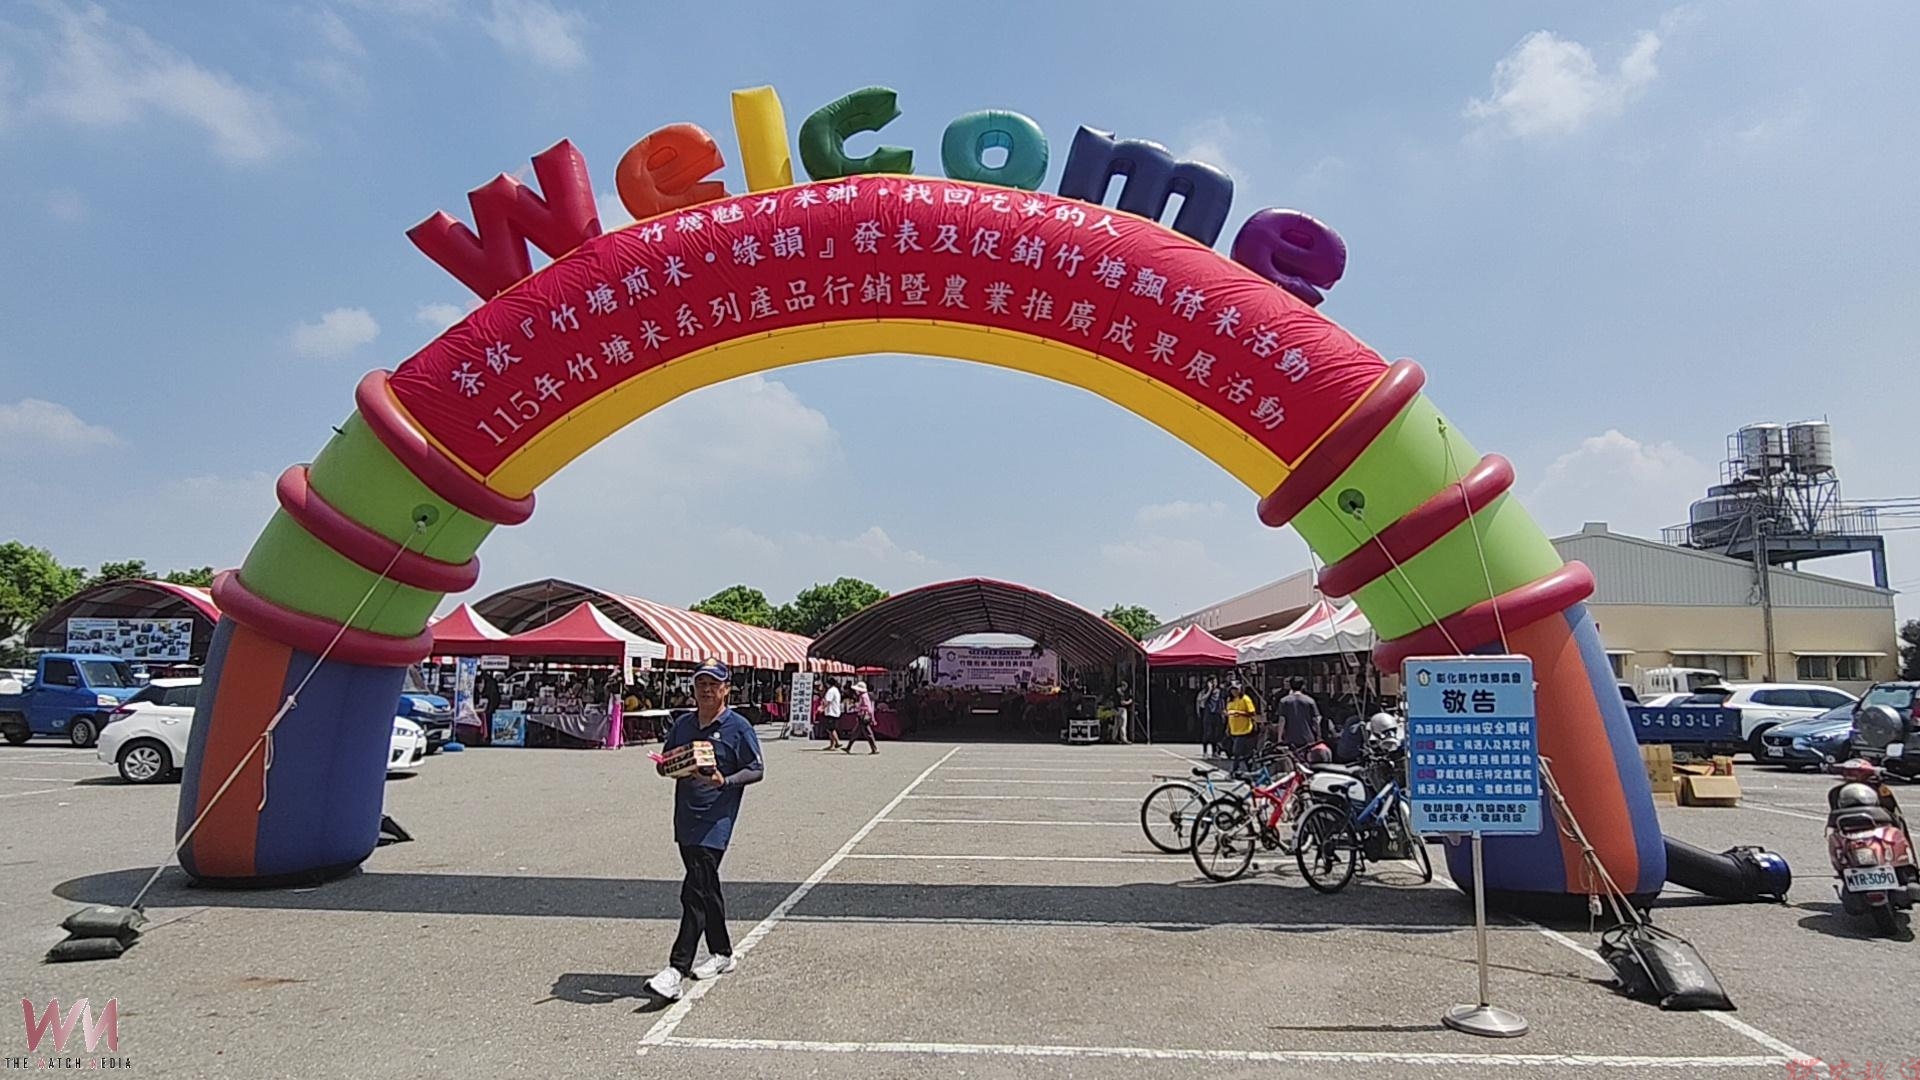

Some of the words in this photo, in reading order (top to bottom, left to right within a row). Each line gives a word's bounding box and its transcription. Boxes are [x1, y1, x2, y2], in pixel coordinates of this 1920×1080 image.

[406, 85, 1348, 305] Welcome
[476, 271, 1287, 447] 115年竹塘米系列產品行銷暨農業推廣成果展活動
[1441, 689, 1496, 713] 敬告
